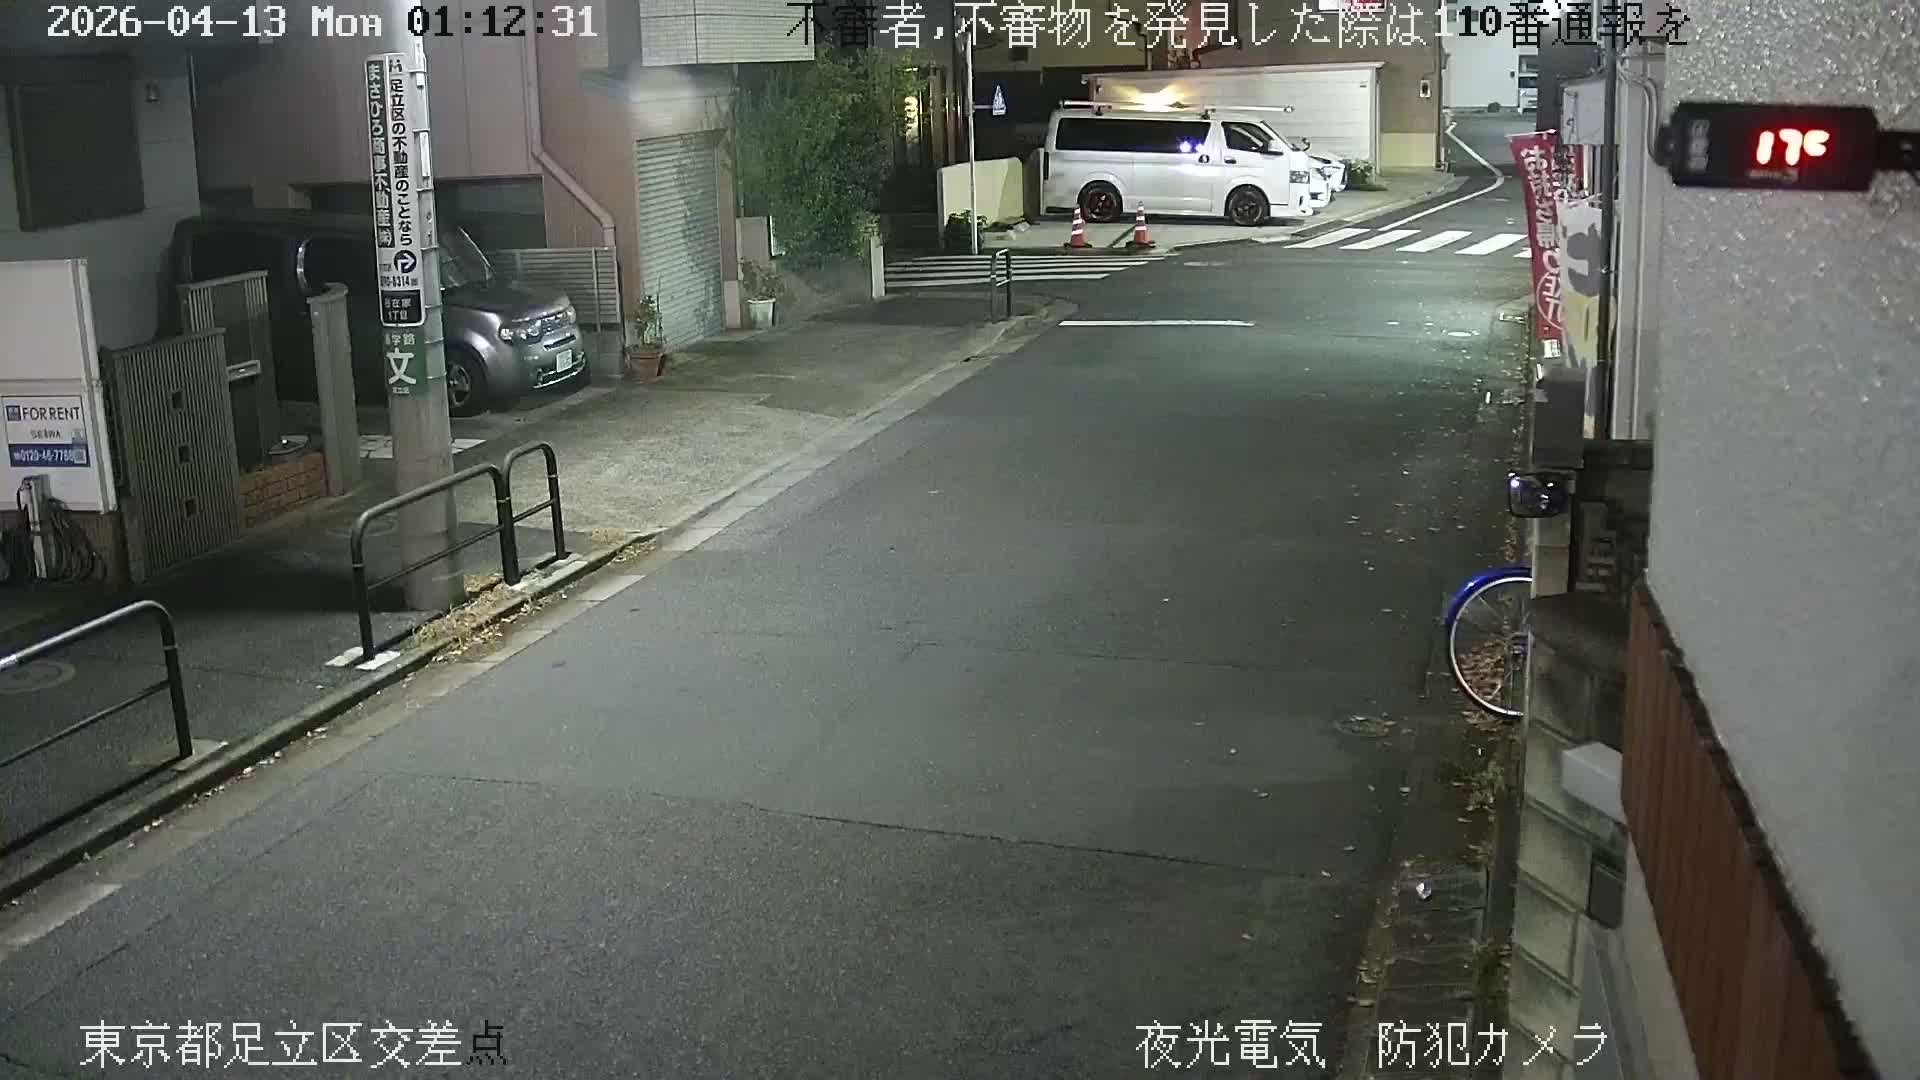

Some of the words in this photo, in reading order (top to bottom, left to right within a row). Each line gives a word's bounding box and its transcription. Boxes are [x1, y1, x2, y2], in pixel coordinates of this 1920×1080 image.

[390, 79, 413, 246] 足立区の不動産のことなら
[386, 347, 417, 385] 文
[22, 407, 48, 421] FOR
[48, 406, 80, 420] RENT
